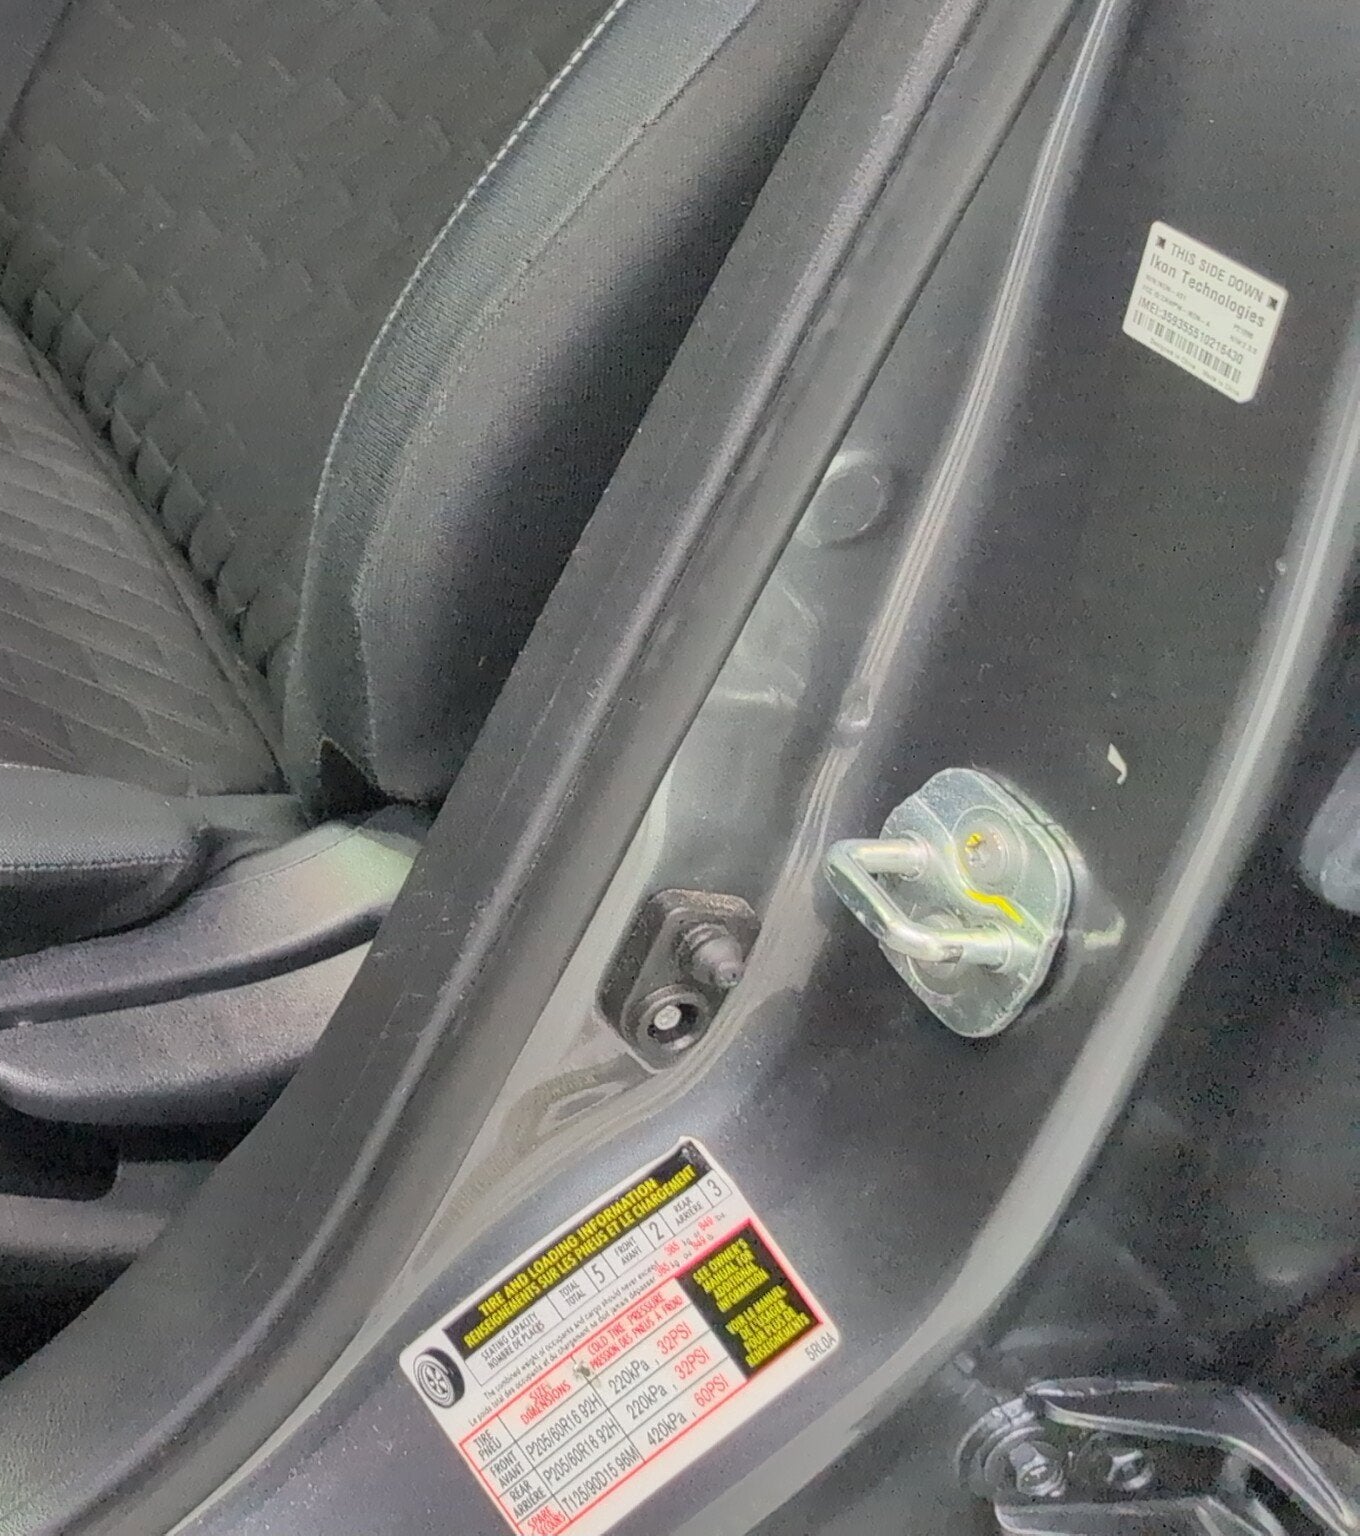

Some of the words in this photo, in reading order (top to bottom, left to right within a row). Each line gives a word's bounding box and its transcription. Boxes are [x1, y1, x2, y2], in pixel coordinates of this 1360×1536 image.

[1170, 243, 1196, 266] THIS
[1198, 257, 1226, 282] SIDE
[1227, 274, 1264, 303] DOWN
[1149, 252, 1178, 279] Ikon
[1178, 268, 1267, 331] Technologies
[705, 1176, 723, 1198] 3
[647, 1219, 665, 1241] 2
[462, 1281, 542, 1348] RENSEIGNEMENTS
[536, 1265, 561, 1290] SUR
[556, 1252, 578, 1274] LES
[573, 1228, 609, 1262] PNEUS
[604, 1219, 622, 1238] ET
[618, 1210, 634, 1228] LE
[630, 1163, 697, 1220] CHARGEMENT
[477, 1290, 506, 1317] TIRE
[501, 1272, 530, 1299] AND
[526, 1233, 579, 1279] LOADING
[576, 1177, 659, 1243] INFORMATION
[613, 1235, 637, 1257] FRONT
[619, 1244, 642, 1265] AVANT
[589, 1262, 607, 1283] 5
[558, 1278, 580, 1299] TOTAL
[564, 1287, 586, 1307] TOTAL
[479, 1334, 509, 1360] SEATING
[506, 1311, 538, 1339] CAPACITY
[586, 1334, 609, 1356] COLD
[607, 1321, 625, 1339] TIRE
[626, 1290, 665, 1326] PRESSURE
[486, 1344, 514, 1369] NOMBRE
[510, 1336, 523, 1350] DE
[519, 1319, 545, 1342] PLACES
[589, 1342, 620, 1370] PRESSION
[606, 1354, 650, 1395] 220kPa
[655, 1320, 693, 1356] 32PSI
[624, 1379, 667, 1420] 220kPa
[672, 1345, 710, 1380] 32PSI
[519, 1379, 571, 1425] DIMENSIONS
[643, 1406, 687, 1448] 420kPa
[692, 1372, 729, 1408] 60PSI
[473, 1429, 493, 1449] TIRE
[524, 1408, 583, 1461] P205/60R16
[576, 1392, 602, 1419] 92H
[593, 1417, 620, 1444] 92H
[477, 1437, 503, 1461] PNEU
[488, 1449, 518, 1477] FRONT
[496, 1461, 526, 1489] AVANT
[561, 1461, 619, 1514] T125/90D15
[613, 1444, 639, 1471] 96M
[508, 1479, 532, 1502] REAR
[526, 1505, 553, 1531] SPARE
